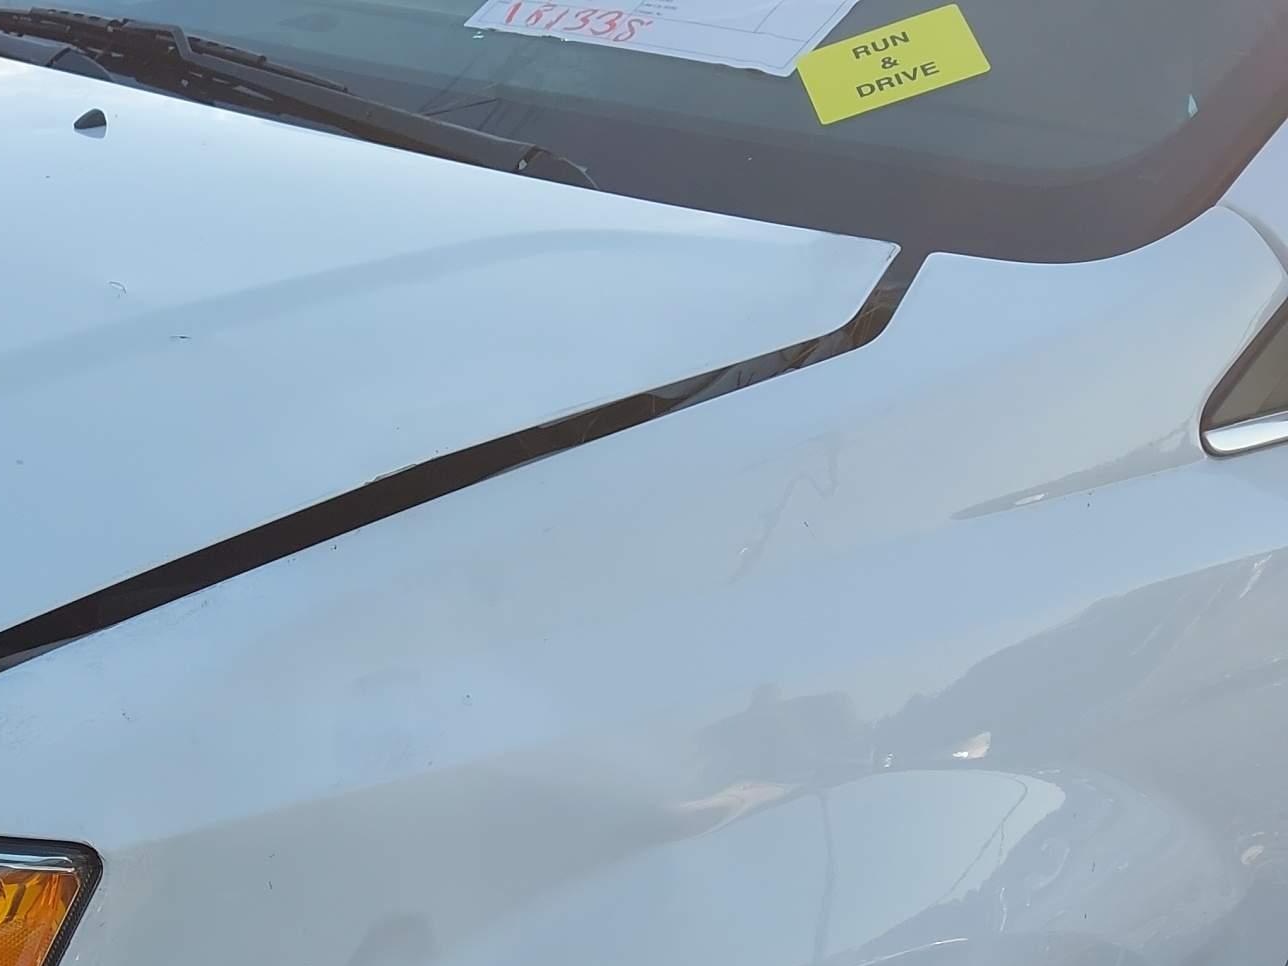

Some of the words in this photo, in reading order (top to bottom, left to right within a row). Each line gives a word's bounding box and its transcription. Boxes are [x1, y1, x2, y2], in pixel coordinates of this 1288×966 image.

[852, 31, 910, 59] RUN
[881, 56, 899, 69] &
[856, 62, 940, 98] DRIVE
